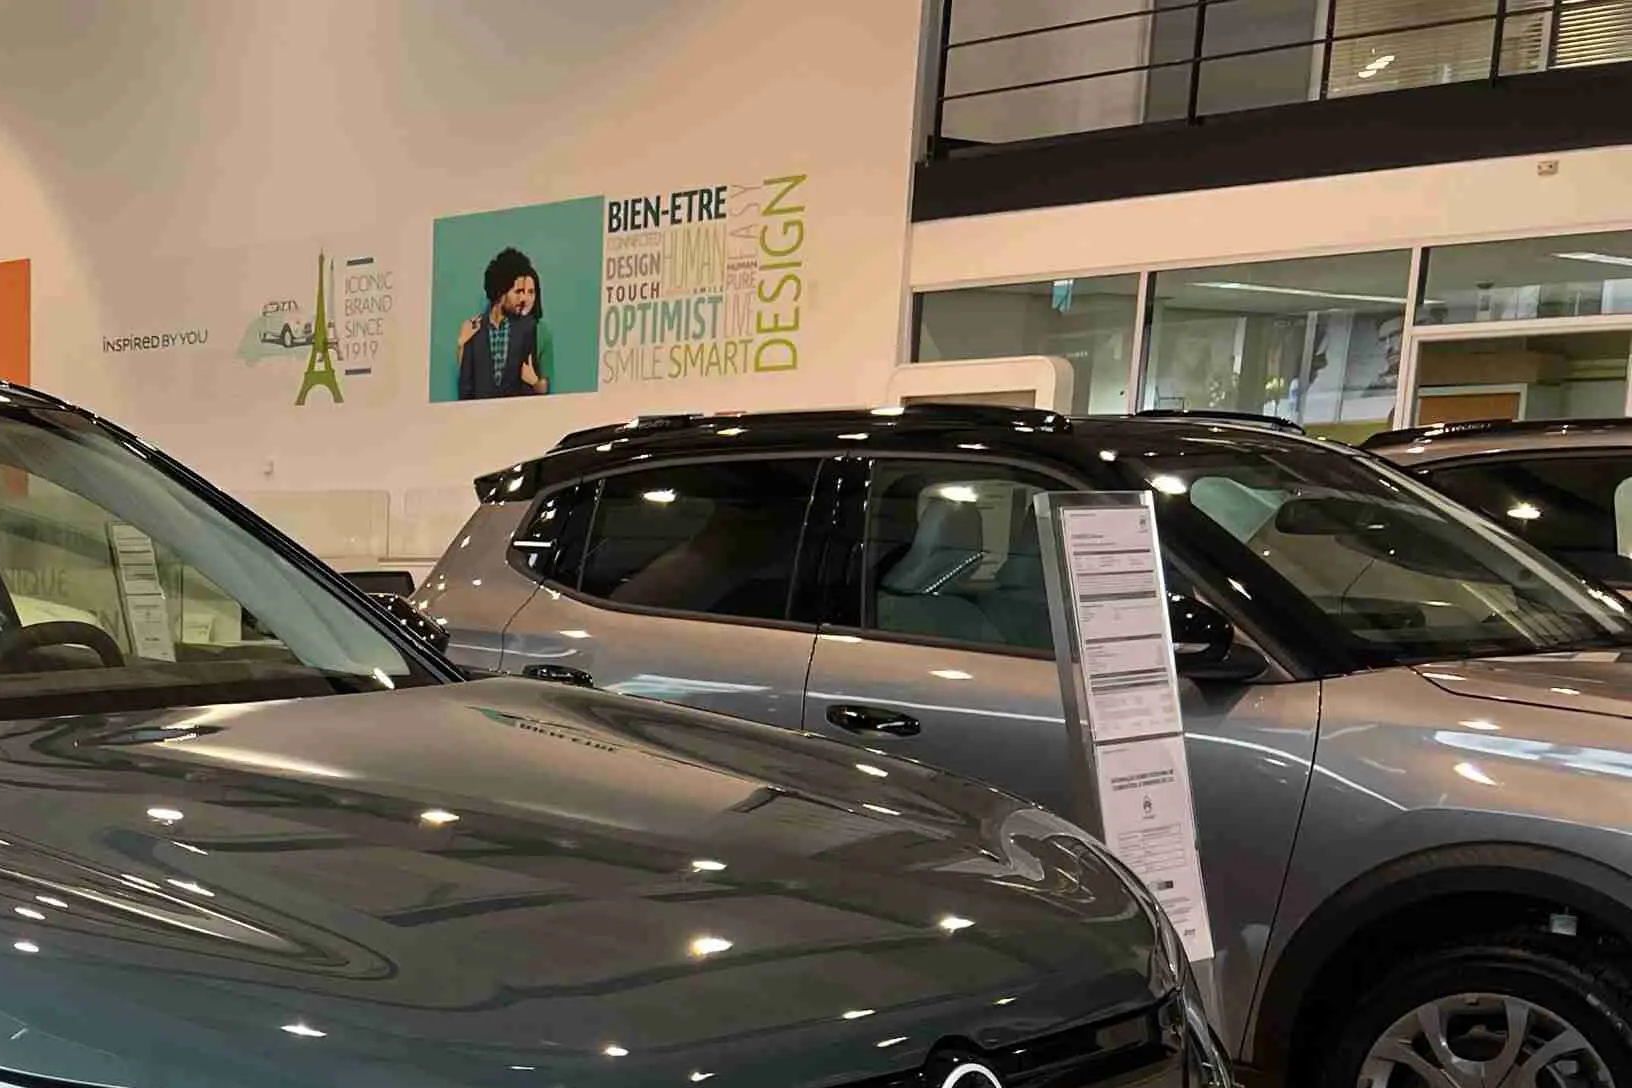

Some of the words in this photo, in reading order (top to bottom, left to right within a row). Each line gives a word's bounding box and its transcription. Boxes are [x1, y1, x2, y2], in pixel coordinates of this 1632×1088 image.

[607, 185, 728, 233] BIEN-ETRE
[605, 252, 662, 281] DESIGN
[754, 173, 808, 373] DESIGN
[344, 271, 394, 295] ICONIC
[606, 282, 661, 304] TOUCH
[344, 294, 393, 318] BRAND
[344, 317, 385, 340] SINCE
[603, 293, 724, 349] OPTIMIST
[161, 333, 176, 348] BY
[178, 327, 208, 345] YOU
[345, 340, 379, 362] 1919
[602, 345, 664, 385] SMILE
[667, 338, 754, 380] SMART
